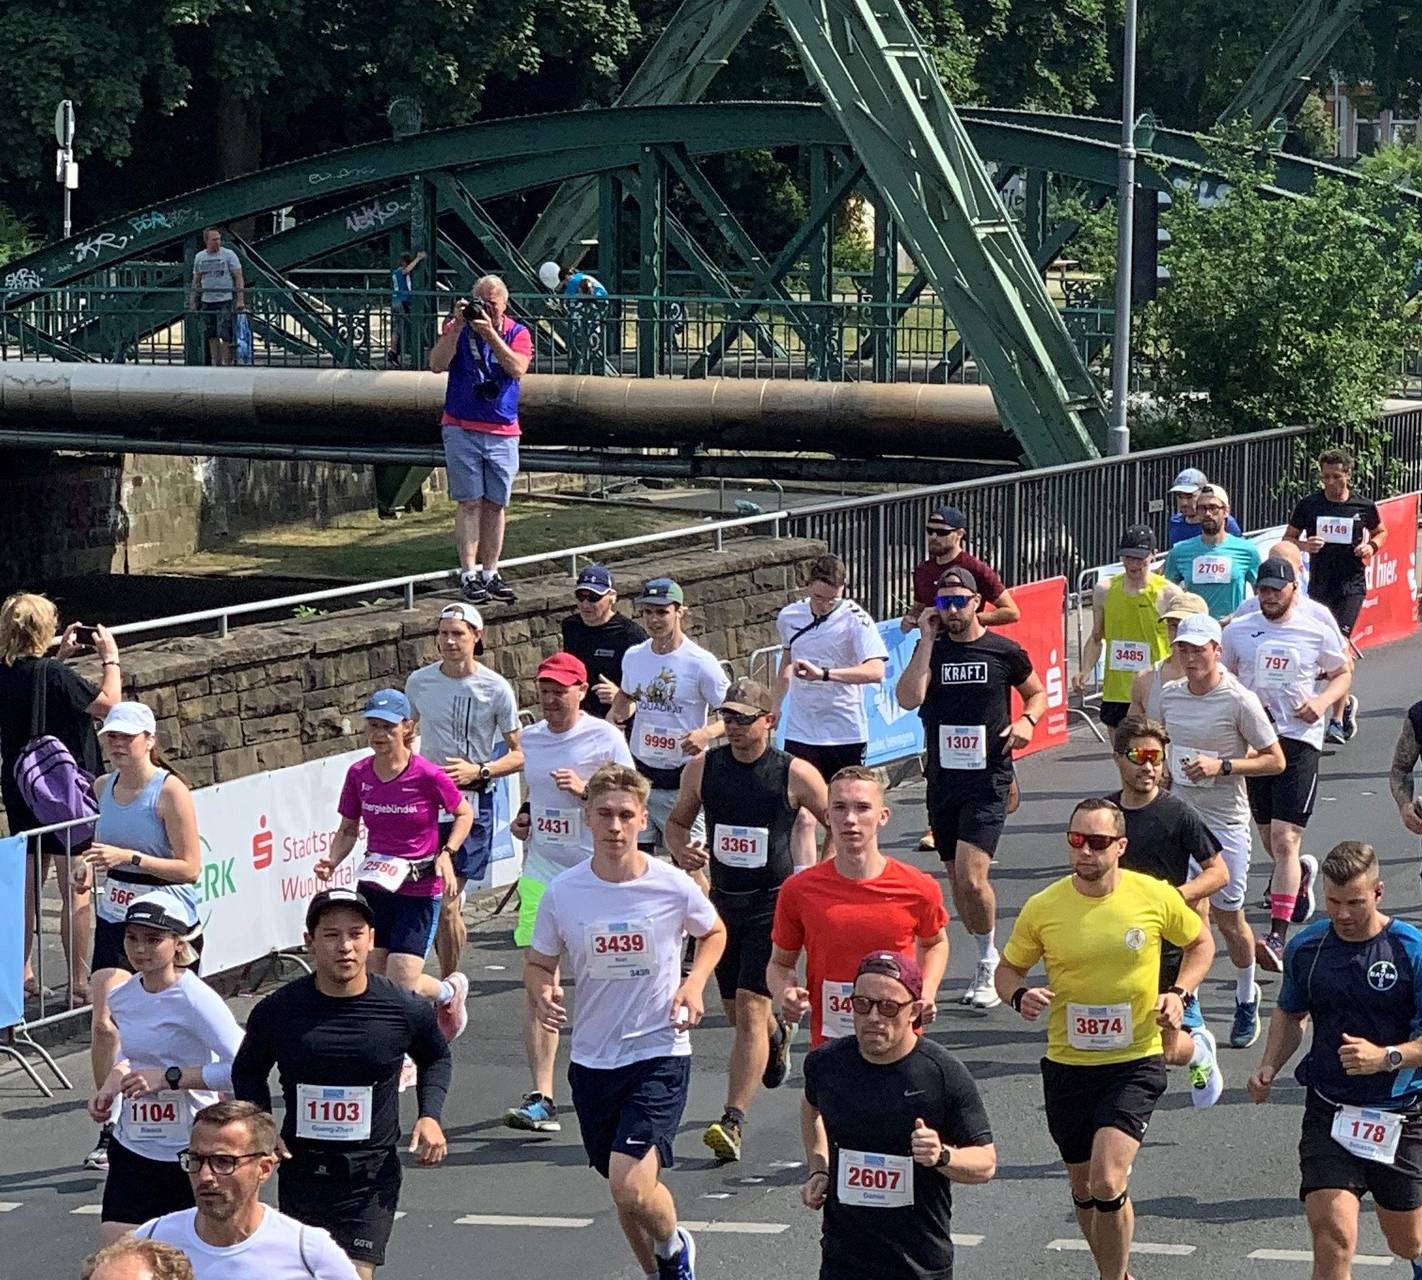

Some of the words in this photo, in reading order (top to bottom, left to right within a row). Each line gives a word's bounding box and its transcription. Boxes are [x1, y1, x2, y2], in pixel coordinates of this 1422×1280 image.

[1198, 563, 1225, 574] 2706
[1115, 648, 1144, 662] 3485
[1264, 656, 1290, 670] 797
[944, 665, 986, 682] KRAFT.
[644, 734, 676, 750] 9999
[946, 735, 980, 749] 1307
[537, 817, 569, 834] 2431
[721, 836, 757, 853] 3361
[363, 860, 399, 876] 2580
[595, 933, 644, 953] 3439
[1076, 1017, 1122, 1034] 3874
[131, 1101, 175, 1122] 1104
[308, 1101, 360, 1122] 1103
[1351, 1120, 1386, 1143] 178
[848, 1166, 901, 1190] 2607
